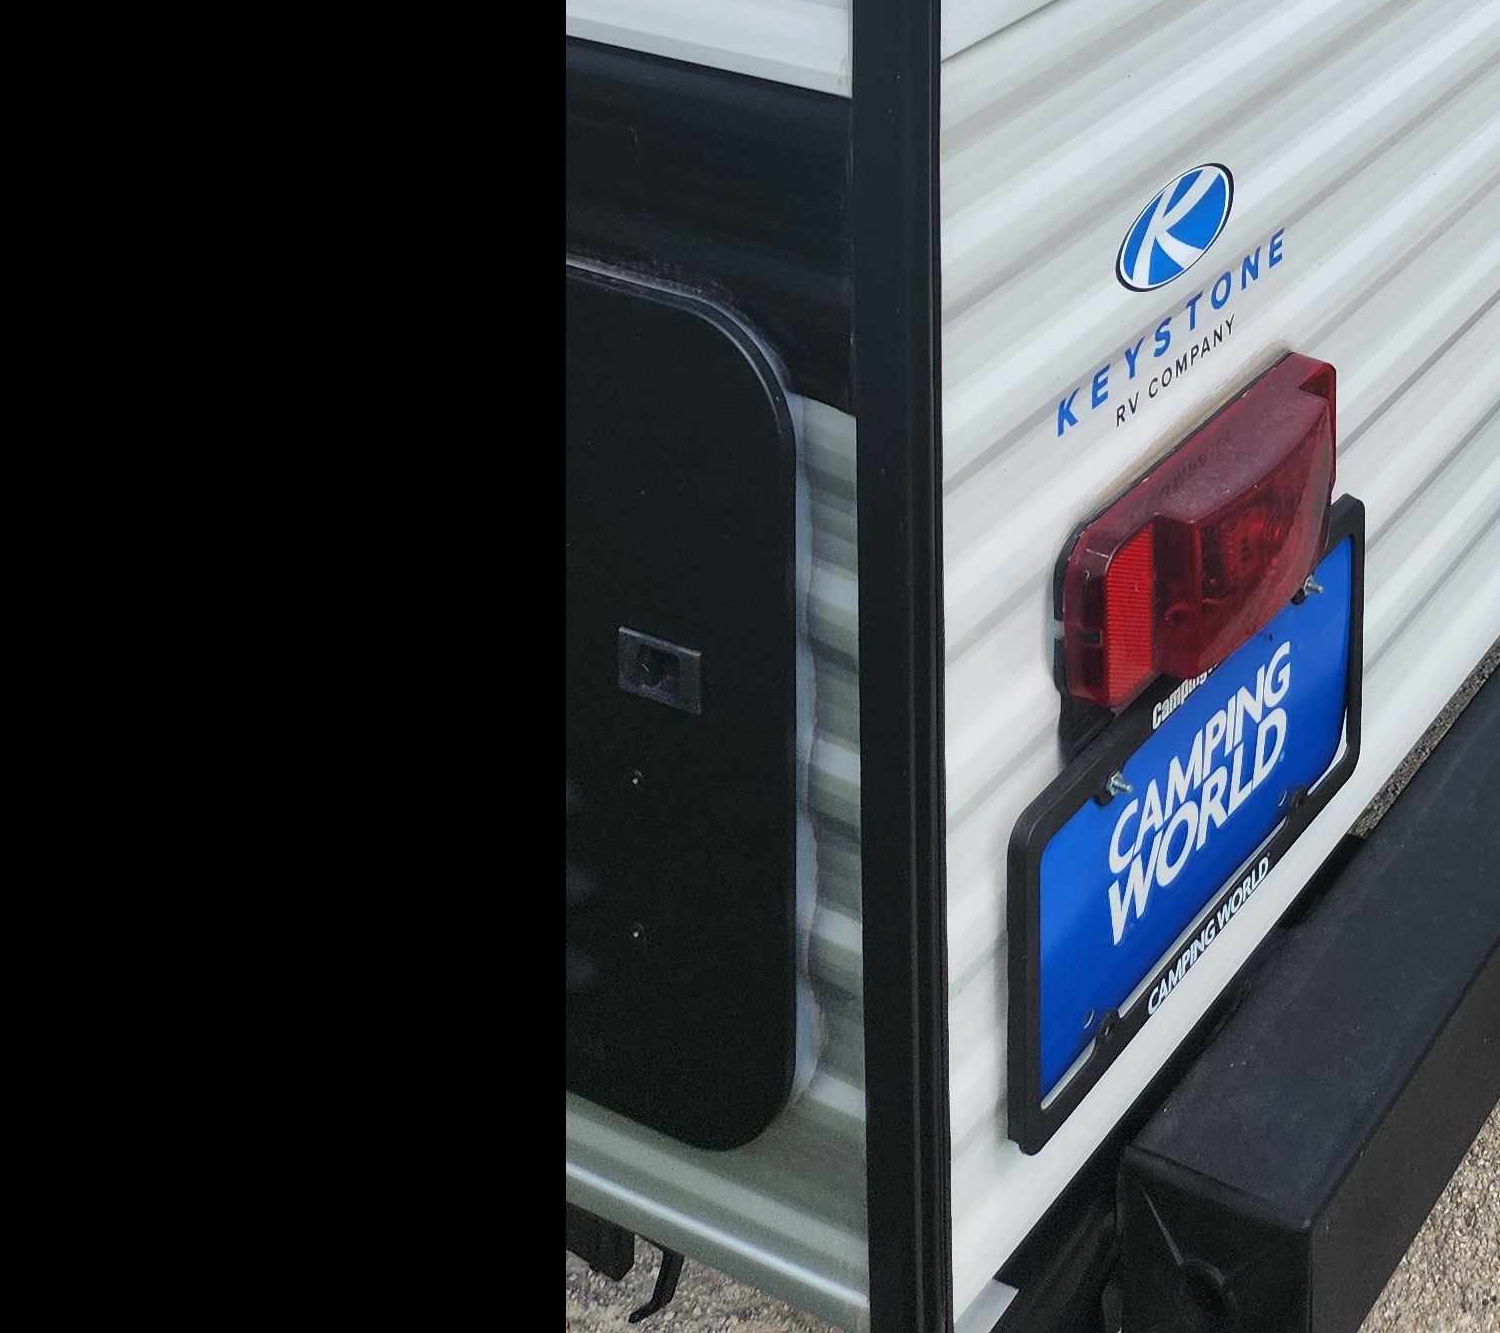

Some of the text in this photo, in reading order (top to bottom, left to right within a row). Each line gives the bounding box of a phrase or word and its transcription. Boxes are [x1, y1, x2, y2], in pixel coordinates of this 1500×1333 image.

[1056, 227, 1286, 438] KEYSTONE
[1116, 314, 1236, 427] RV COMPANY
[1108, 637, 1291, 875] CAMPING
[1108, 707, 1288, 947] WORLD
[1147, 855, 1270, 1016] CAMPING WORLD
